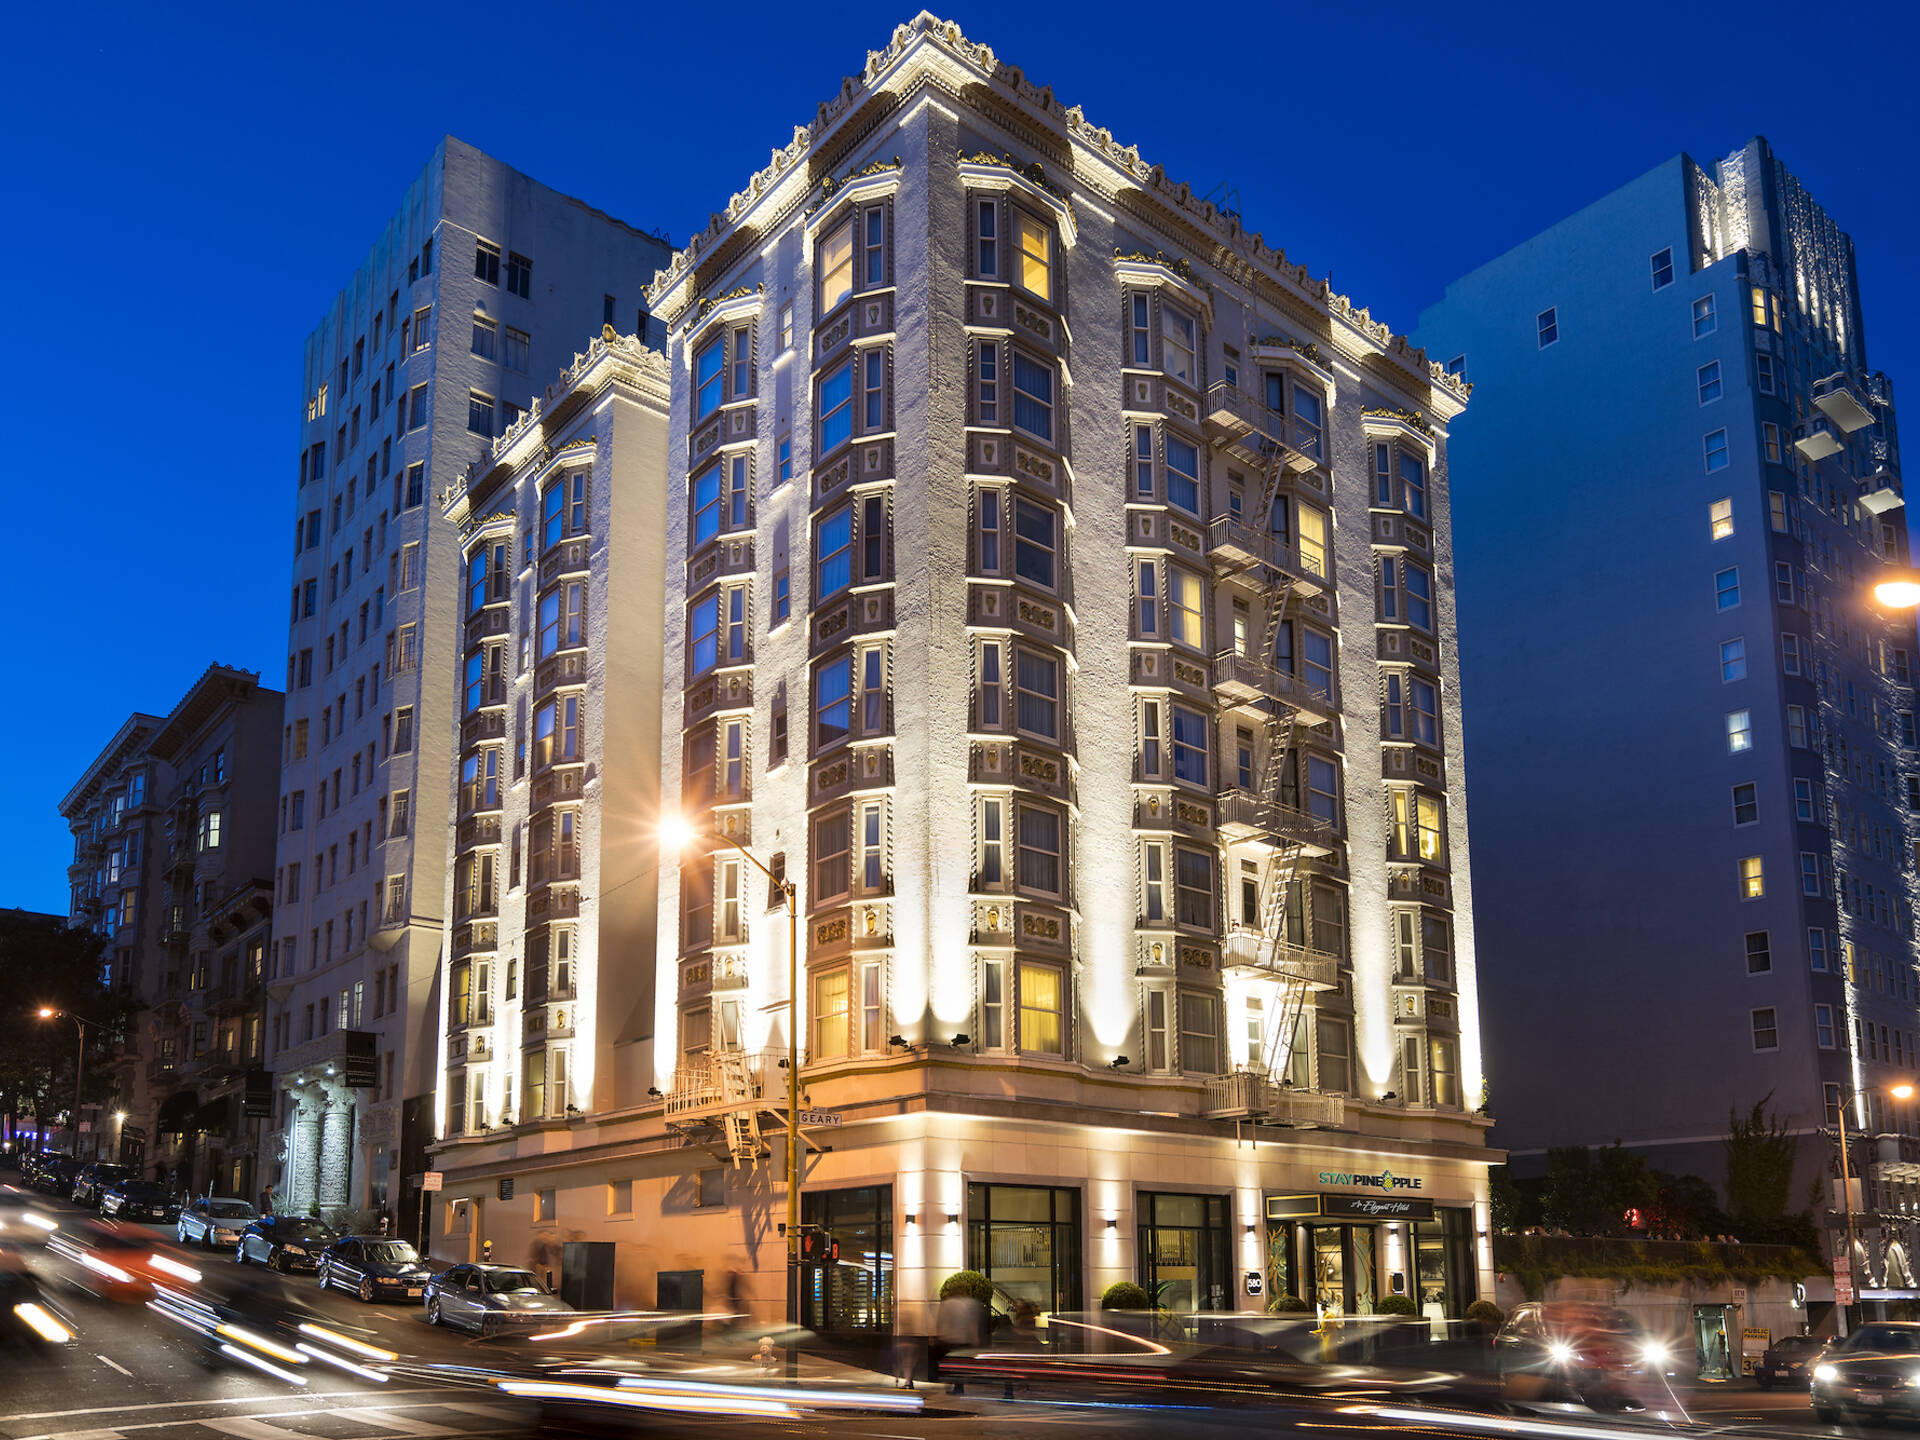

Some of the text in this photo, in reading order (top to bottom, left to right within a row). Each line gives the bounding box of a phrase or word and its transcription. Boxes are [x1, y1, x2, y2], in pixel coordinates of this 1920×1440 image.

[802, 1114, 839, 1124] GEARY
[1319, 1170, 1422, 1192] STAYPINEPPLE
[1361, 1200, 1389, 1214] Elegant
[1389, 1202, 1410, 1213] Hotel
[1248, 1278, 1262, 1287] 580
